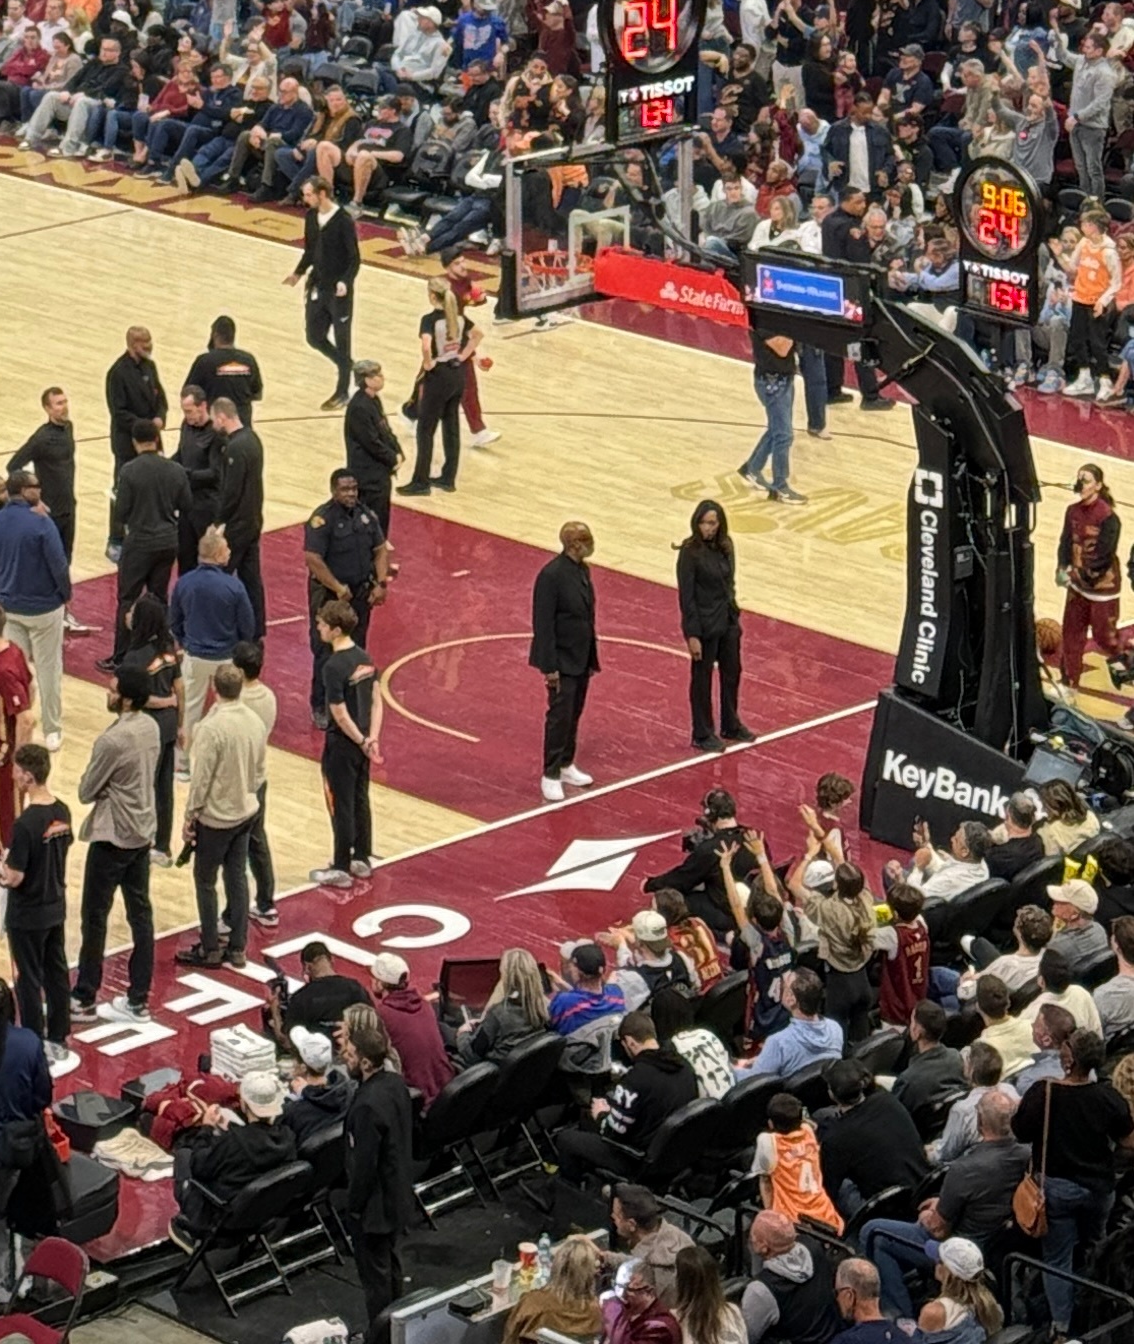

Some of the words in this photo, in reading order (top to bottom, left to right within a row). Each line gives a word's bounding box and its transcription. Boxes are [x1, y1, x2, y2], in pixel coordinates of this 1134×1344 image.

[639, 76, 695, 99] TISSOT
[982, 182, 1027, 217] 9:06
[978, 209, 1019, 249] 24
[981, 265, 1030, 287] TISSOT
[915, 510, 939, 626] Cleveland
[912, 620, 937, 685] Clinic
[883, 750, 1007, 817] KeyBank
